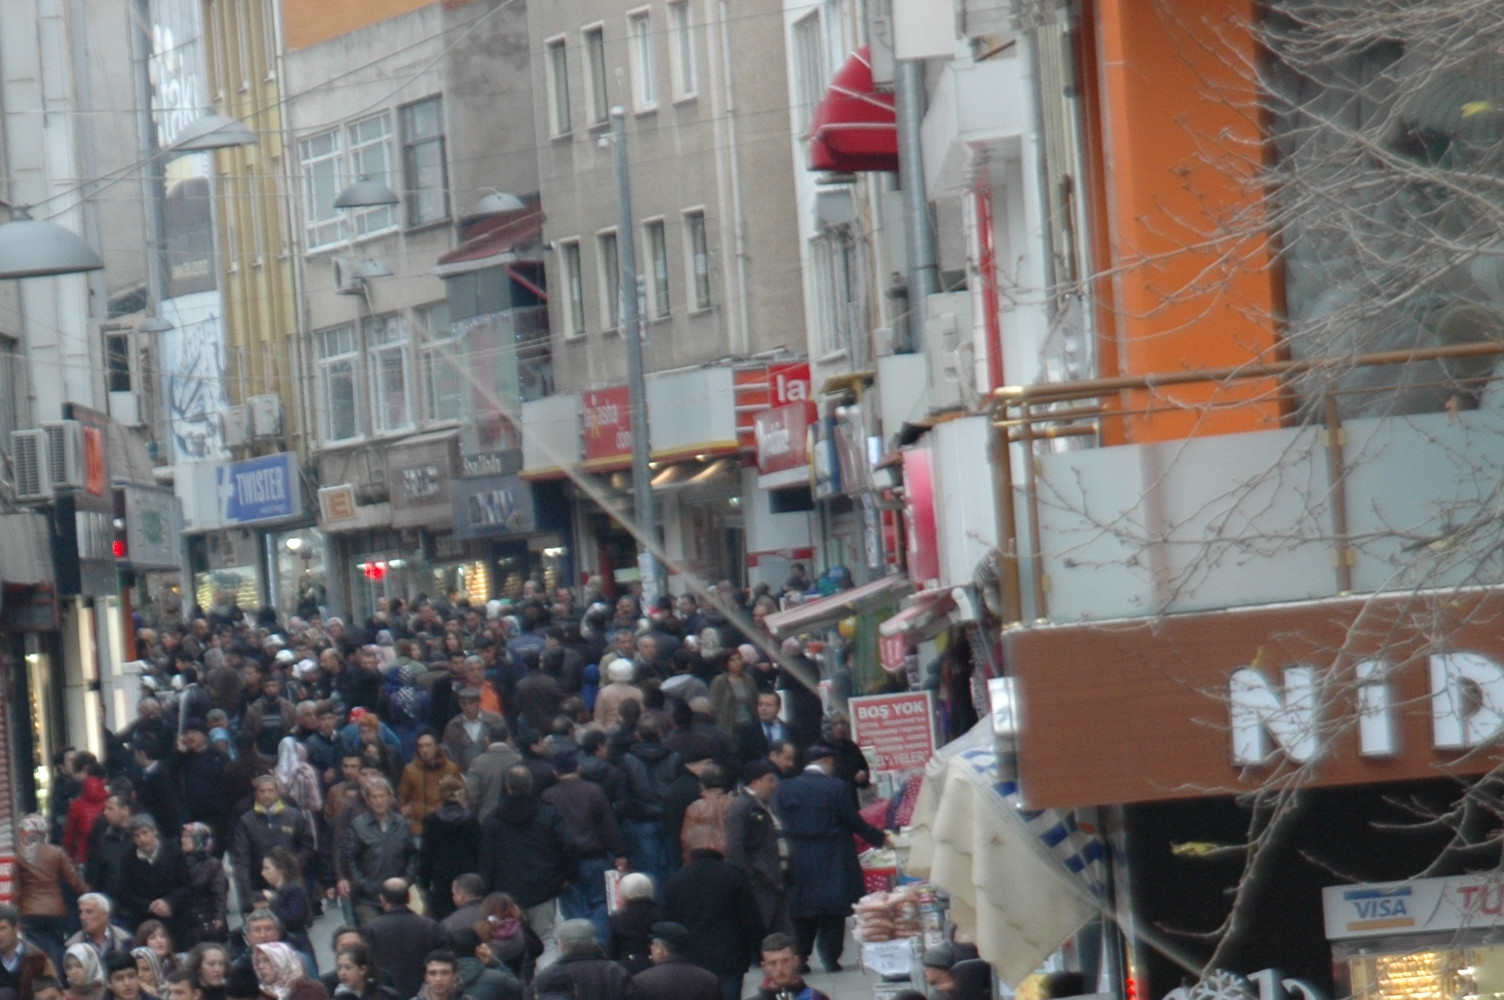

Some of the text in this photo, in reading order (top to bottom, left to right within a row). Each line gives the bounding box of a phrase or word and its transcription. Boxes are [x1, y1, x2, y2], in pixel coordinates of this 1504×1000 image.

[236, 466, 286, 506] TWISTER
[858, 700, 924, 719] BOŞ YOK
[1353, 899, 1407, 920] VISA
